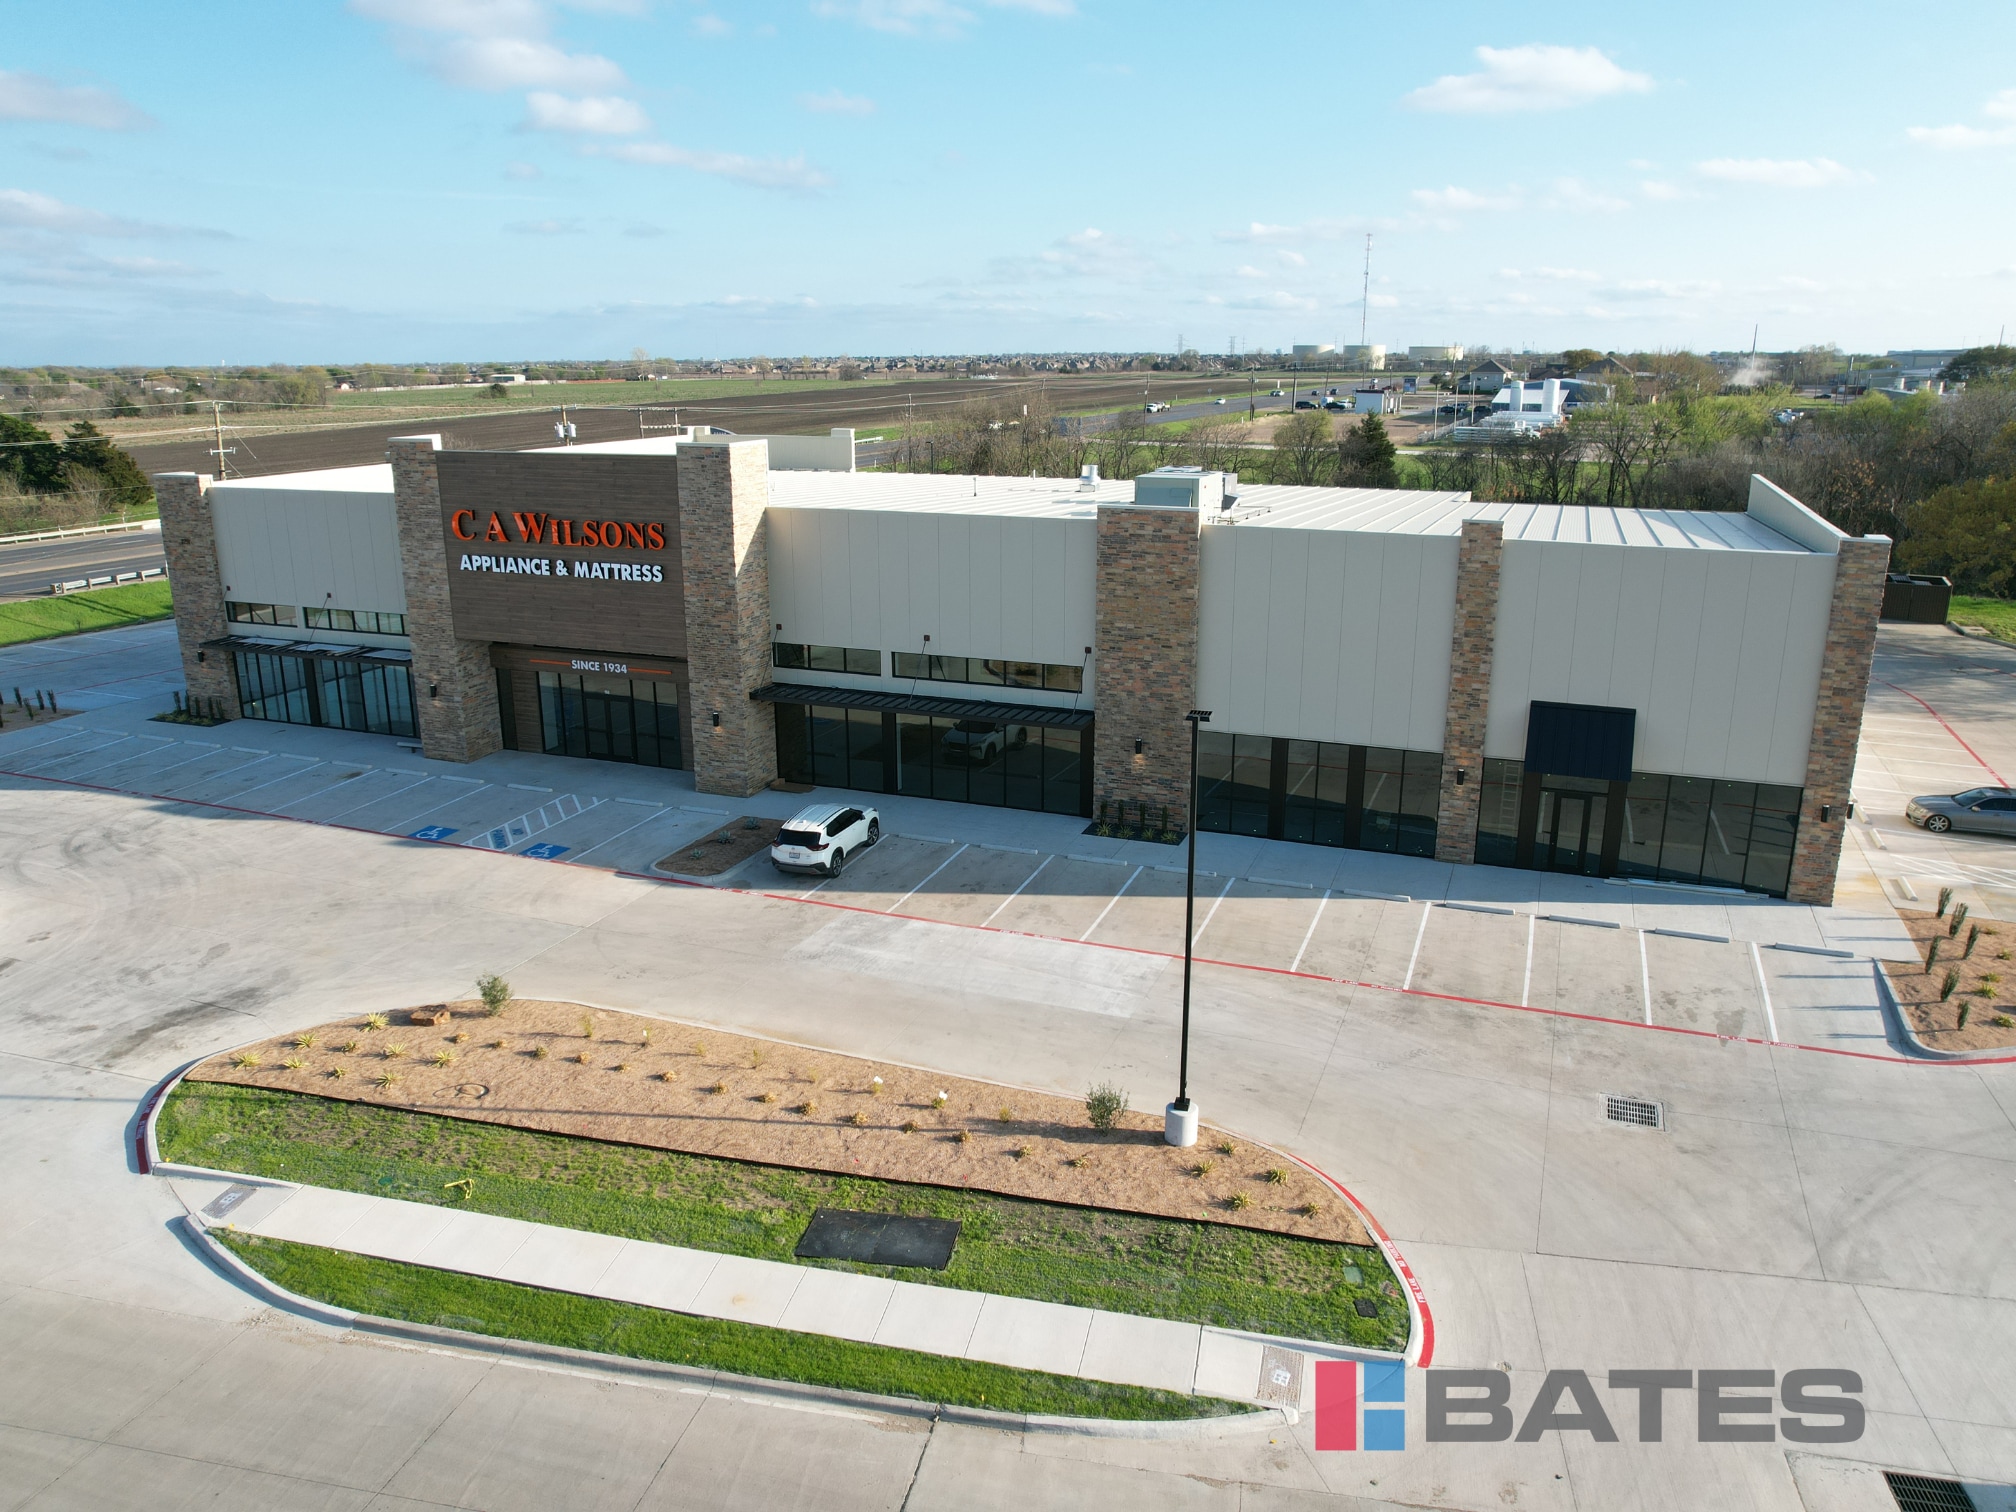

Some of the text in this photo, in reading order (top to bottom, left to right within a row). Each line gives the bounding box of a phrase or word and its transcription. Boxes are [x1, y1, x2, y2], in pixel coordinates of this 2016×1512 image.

[451, 509, 476, 541] C
[484, 511, 510, 543] A
[460, 554, 663, 583] APPLIANCE & MATTRESS
[571, 659, 628, 674] SINCE 1934
